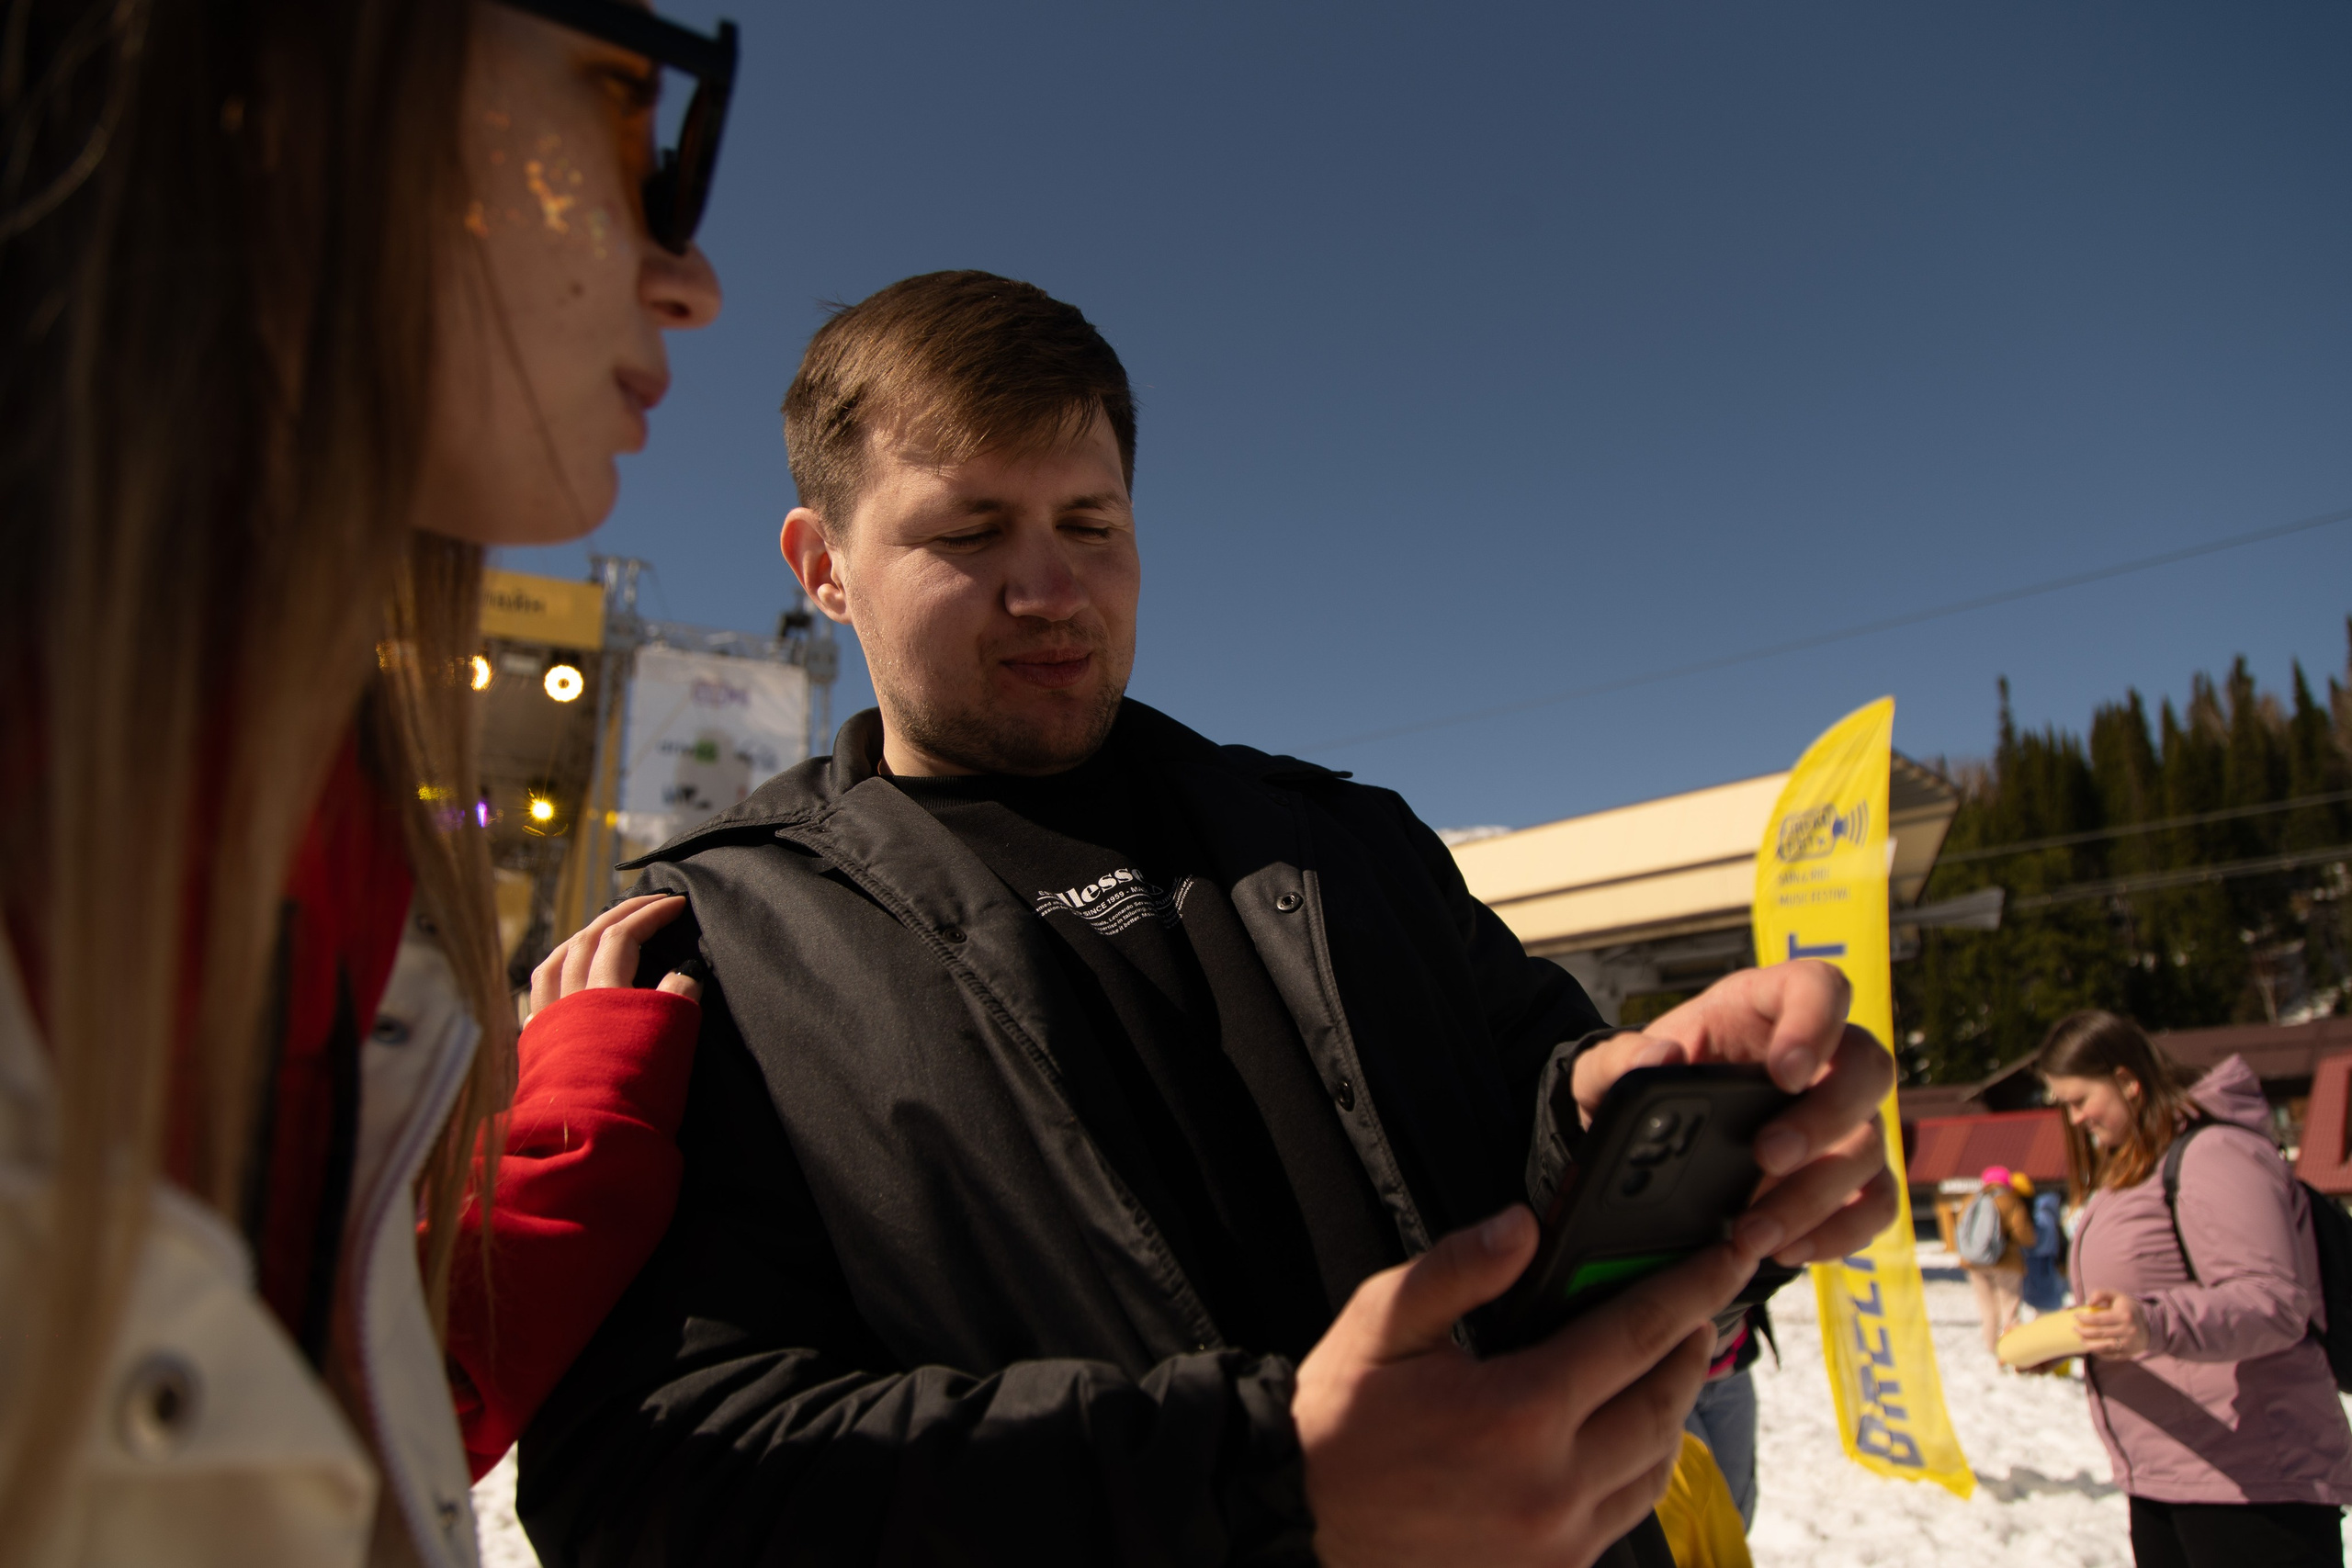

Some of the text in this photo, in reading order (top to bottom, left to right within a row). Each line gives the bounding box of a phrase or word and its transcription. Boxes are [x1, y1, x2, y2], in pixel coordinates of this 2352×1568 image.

[1055, 867, 1163, 908] llesse
[1082, 904, 1108, 918] SINCE
[1107, 890, 1125, 906] 1959
[1108, 904, 1134, 922] Leonardo
